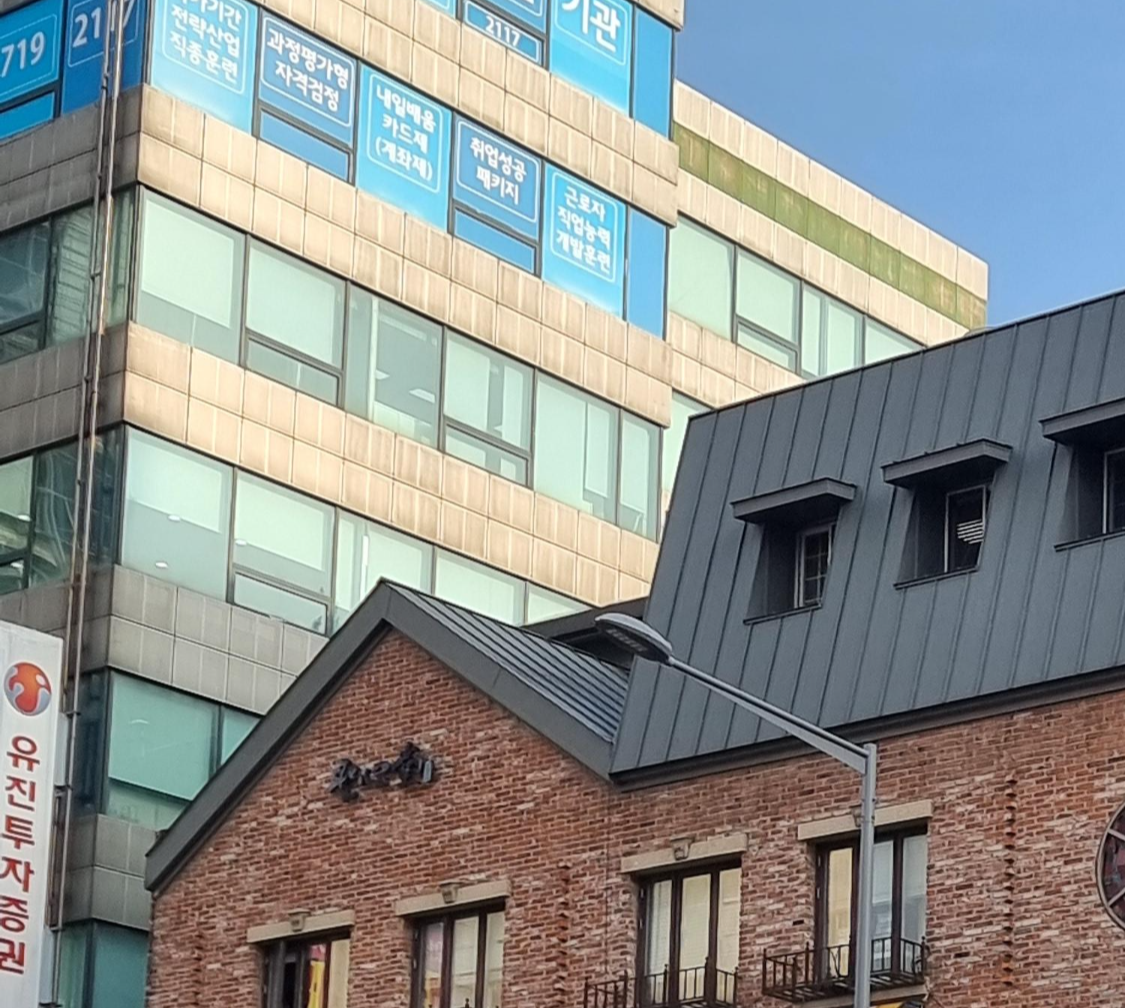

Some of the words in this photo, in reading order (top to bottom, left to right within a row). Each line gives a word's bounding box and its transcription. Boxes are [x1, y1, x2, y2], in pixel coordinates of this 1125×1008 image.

[171, 4, 240, 57] 전략산업
[485, 16, 521, 46] 2117
[169, 30, 238, 83] 직종훈련
[267, 28, 349, 90] 과정평가형
[275, 60, 340, 113] 자격검정
[376, 84, 437, 134] 내일배움
[382, 113, 429, 154] 카드제
[375, 137, 433, 181] (계좌제)
[470, 137, 527, 182] 취업성공
[476, 165, 519, 205] 패키지
[564, 186, 606, 222] 근로자
[558, 205, 611, 250] 직업능력
[556, 229, 611, 275] 개발훈련
[0, 735, 41, 975] 유진투자증권
